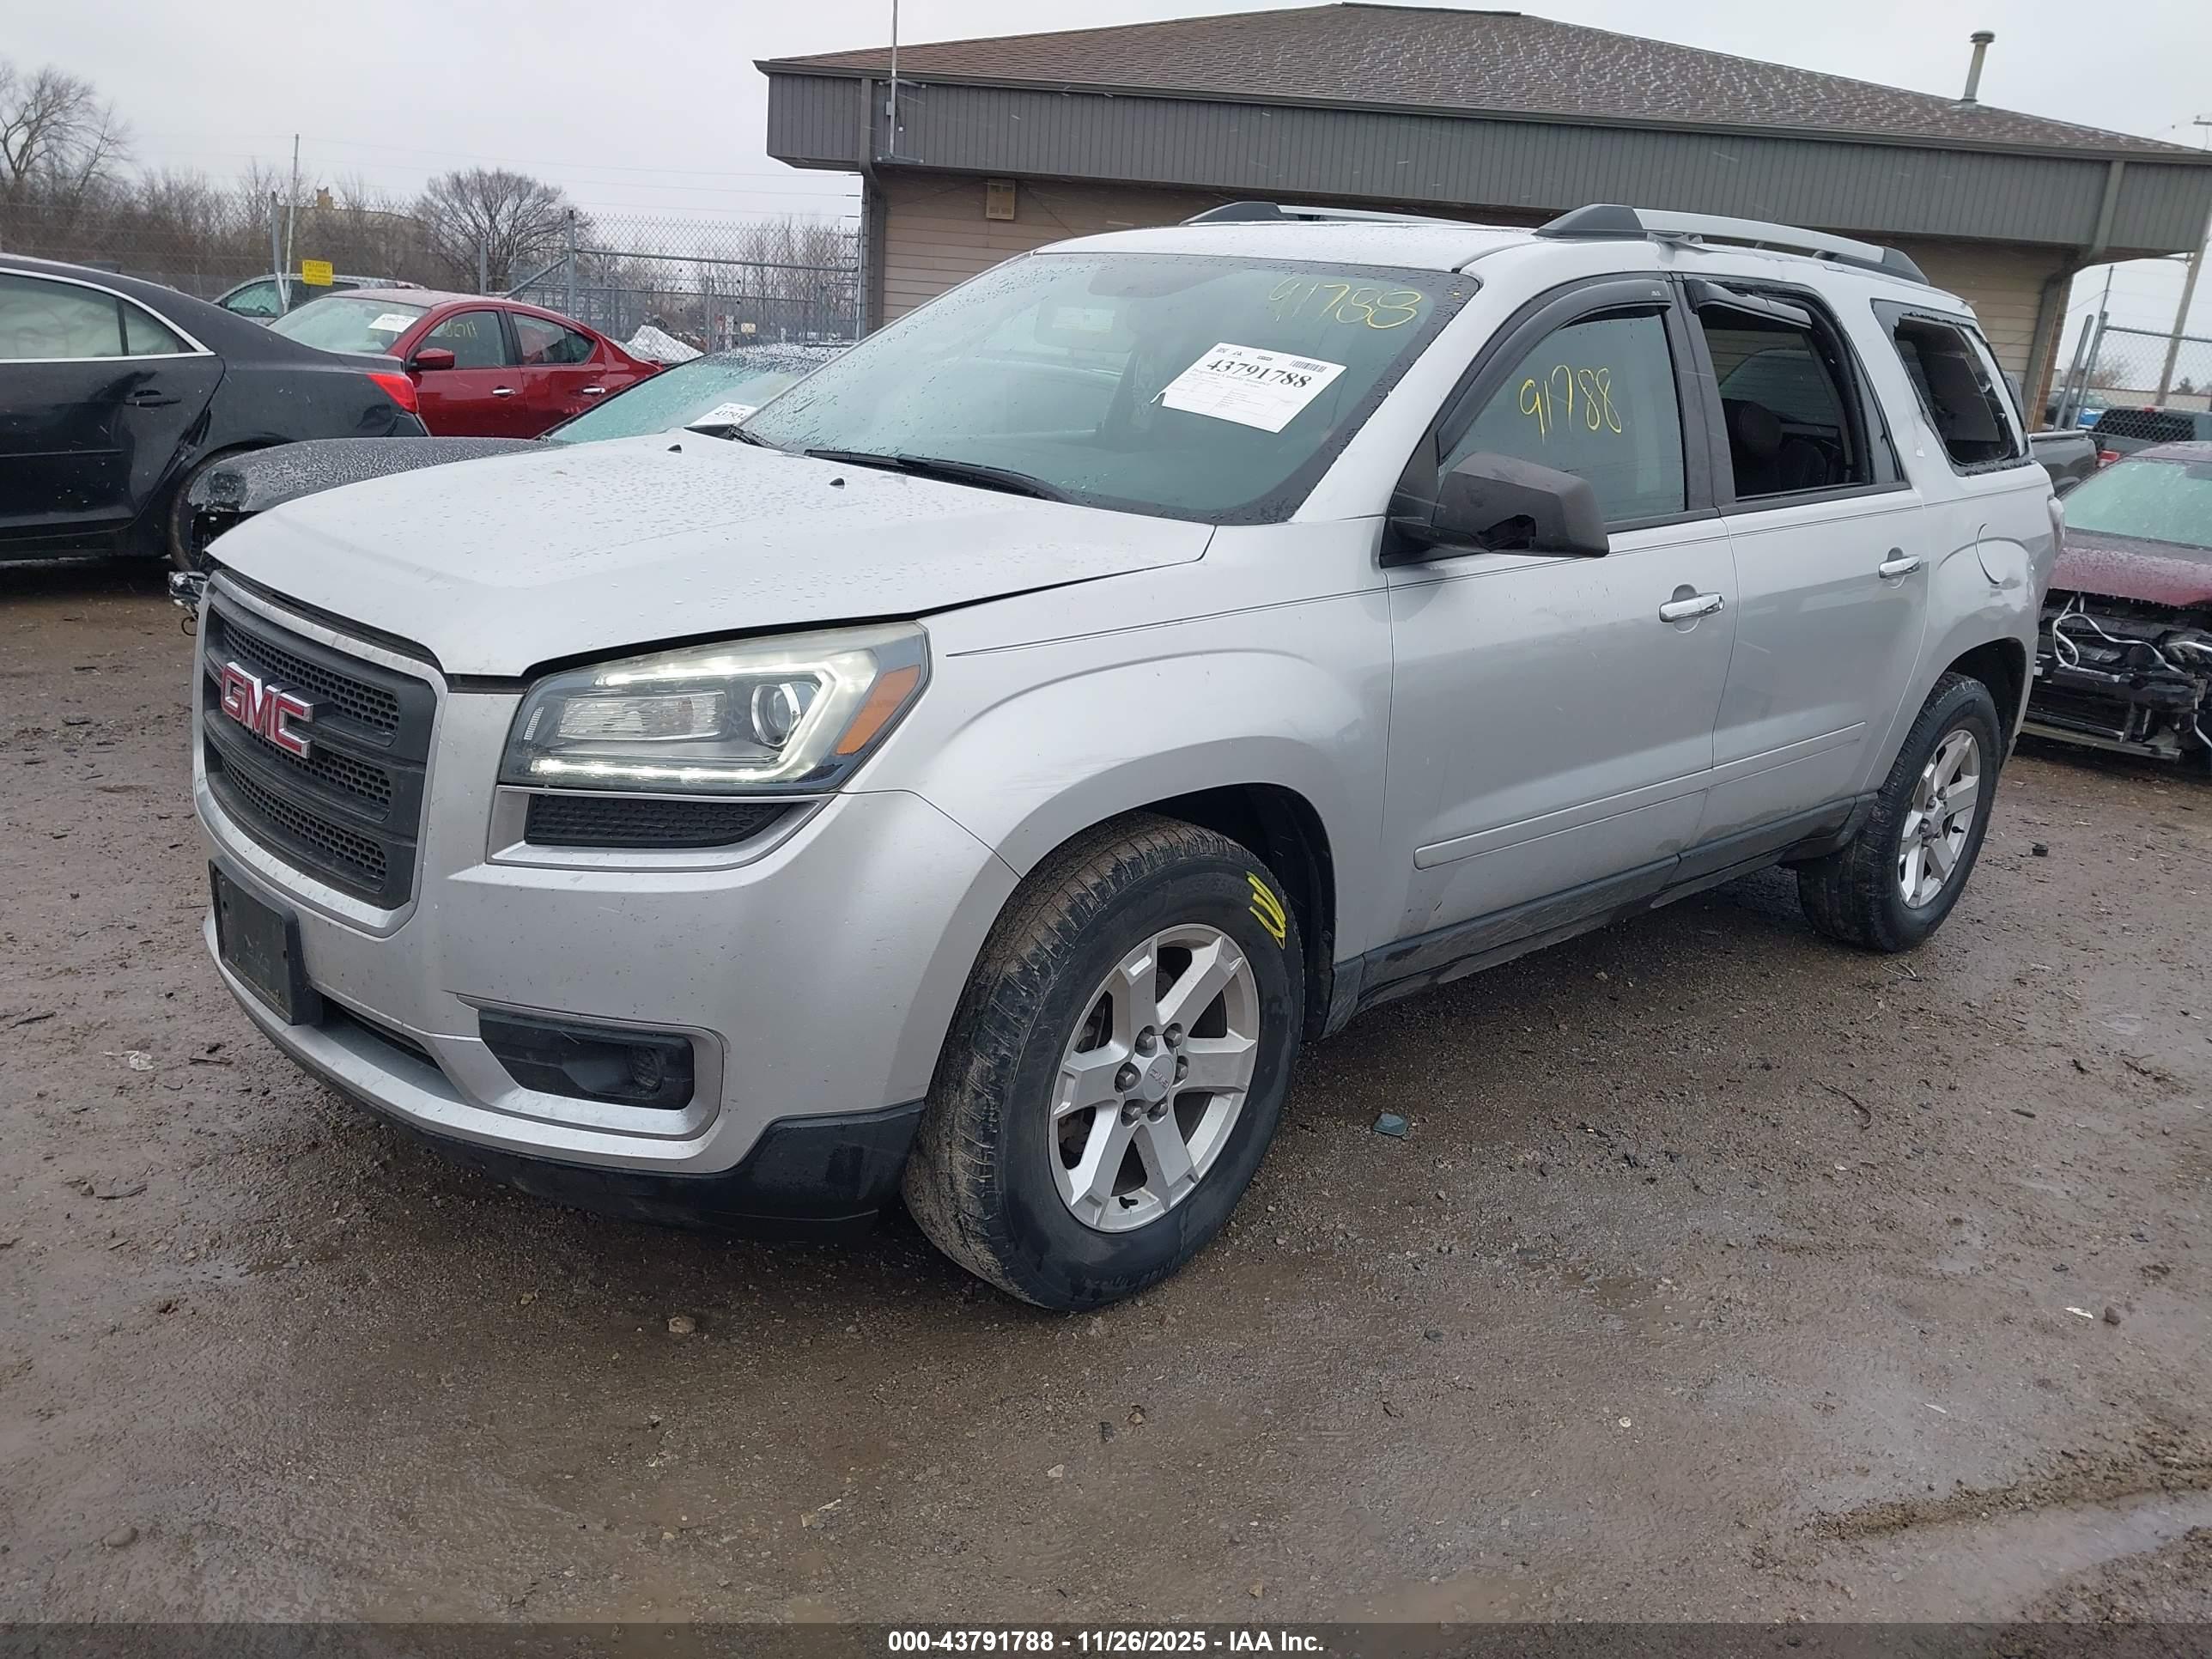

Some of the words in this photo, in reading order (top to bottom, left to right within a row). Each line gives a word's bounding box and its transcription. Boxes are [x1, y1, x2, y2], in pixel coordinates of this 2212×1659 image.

[1270, 277, 1421, 329] 91788
[1206, 359, 1312, 388] 43791788
[1520, 365, 1621, 447] 91788
[221, 661, 314, 759] GMC
